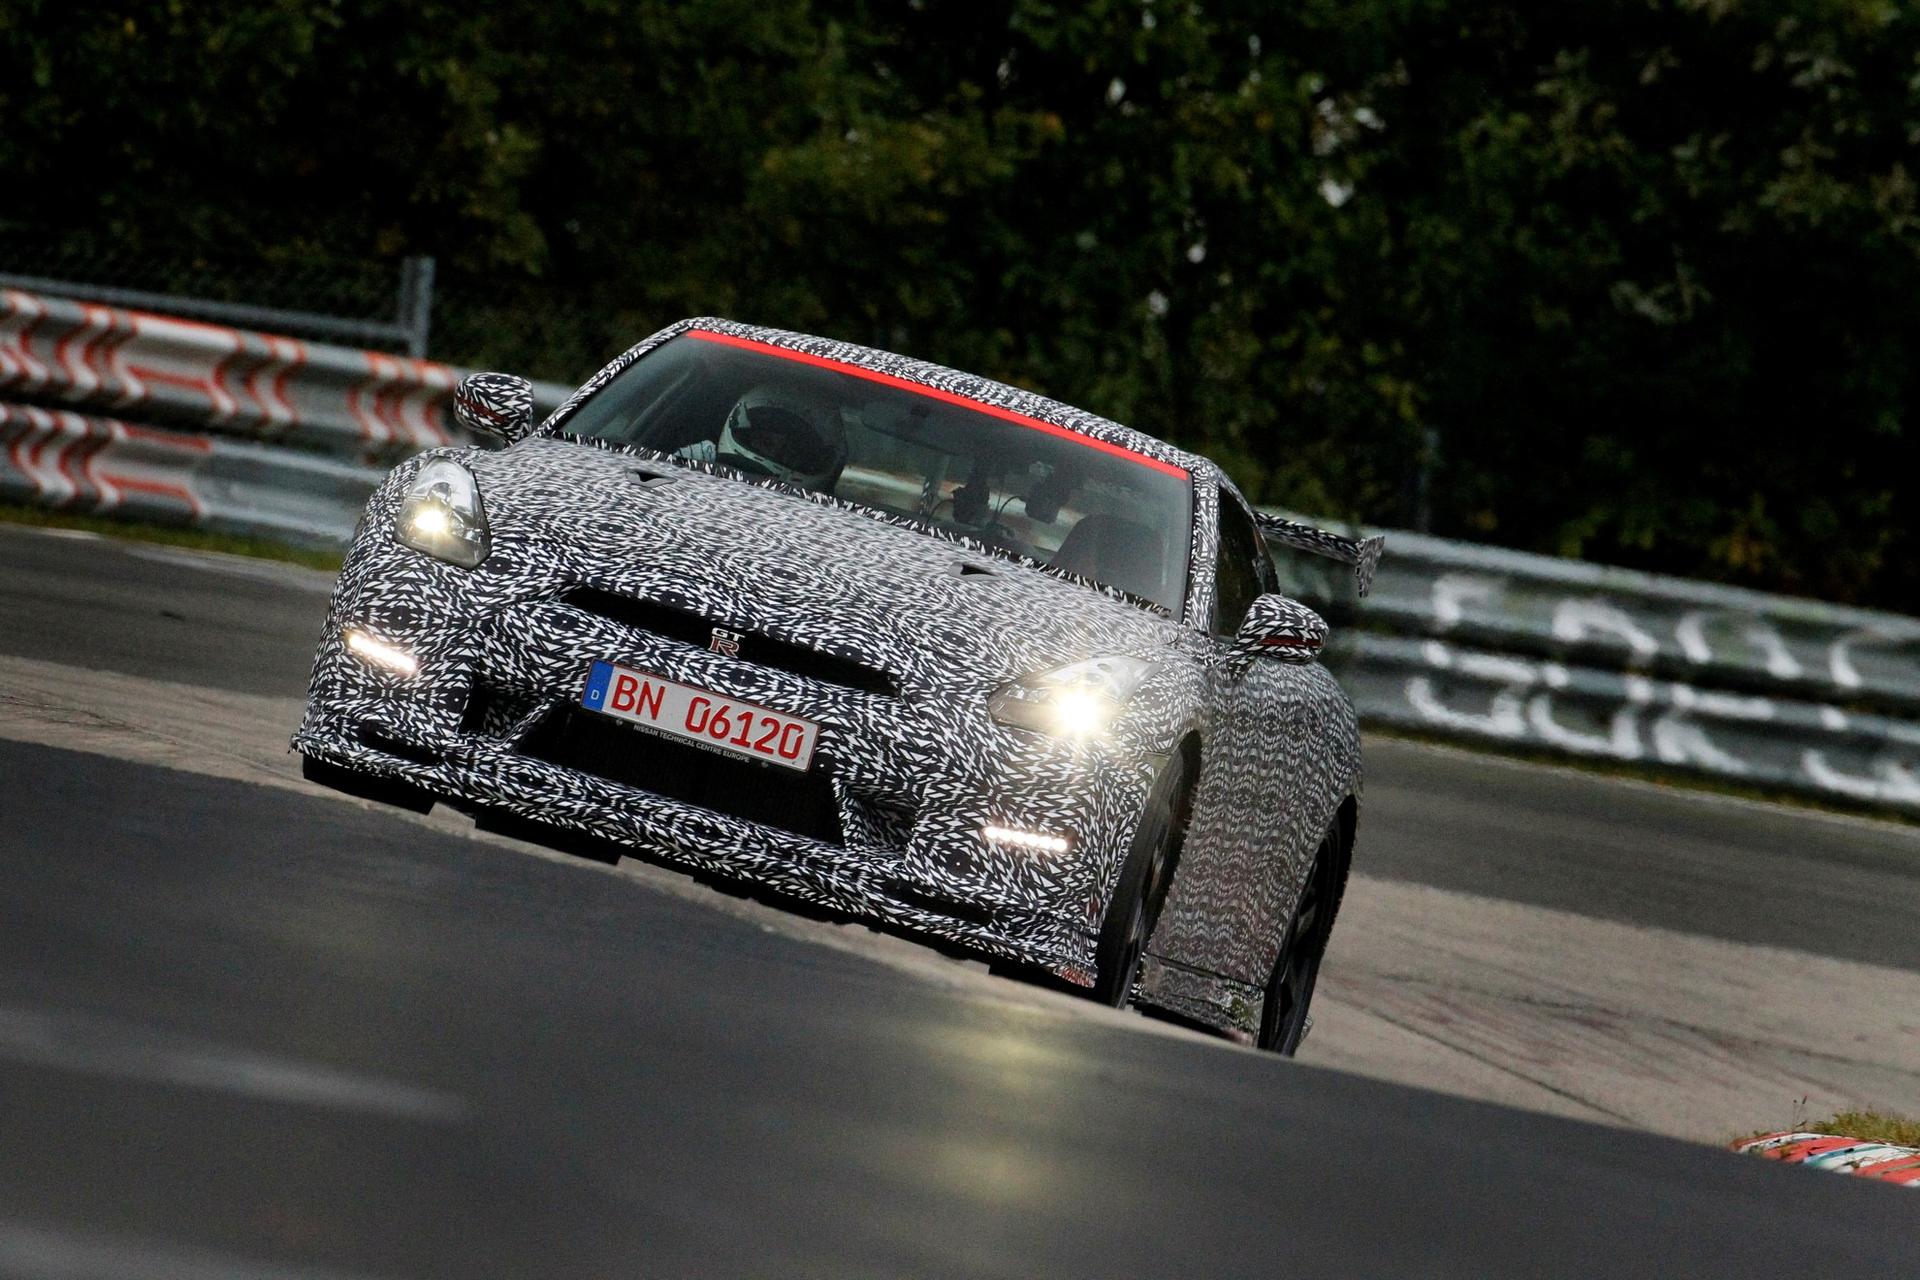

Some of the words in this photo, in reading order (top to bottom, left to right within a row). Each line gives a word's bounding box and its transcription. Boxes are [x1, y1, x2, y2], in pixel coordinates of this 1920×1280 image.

[712, 627, 746, 642] GT
[708, 636, 739, 659] R
[590, 689, 600, 700] D
[611, 674, 665, 720] BN
[685, 696, 804, 760] 06120
[633, 724, 659, 737] NISSAN
[659, 731, 695, 747] TECHNICAL
[696, 742, 721, 755] CENTRE
[722, 750, 750, 763] EUROPE
